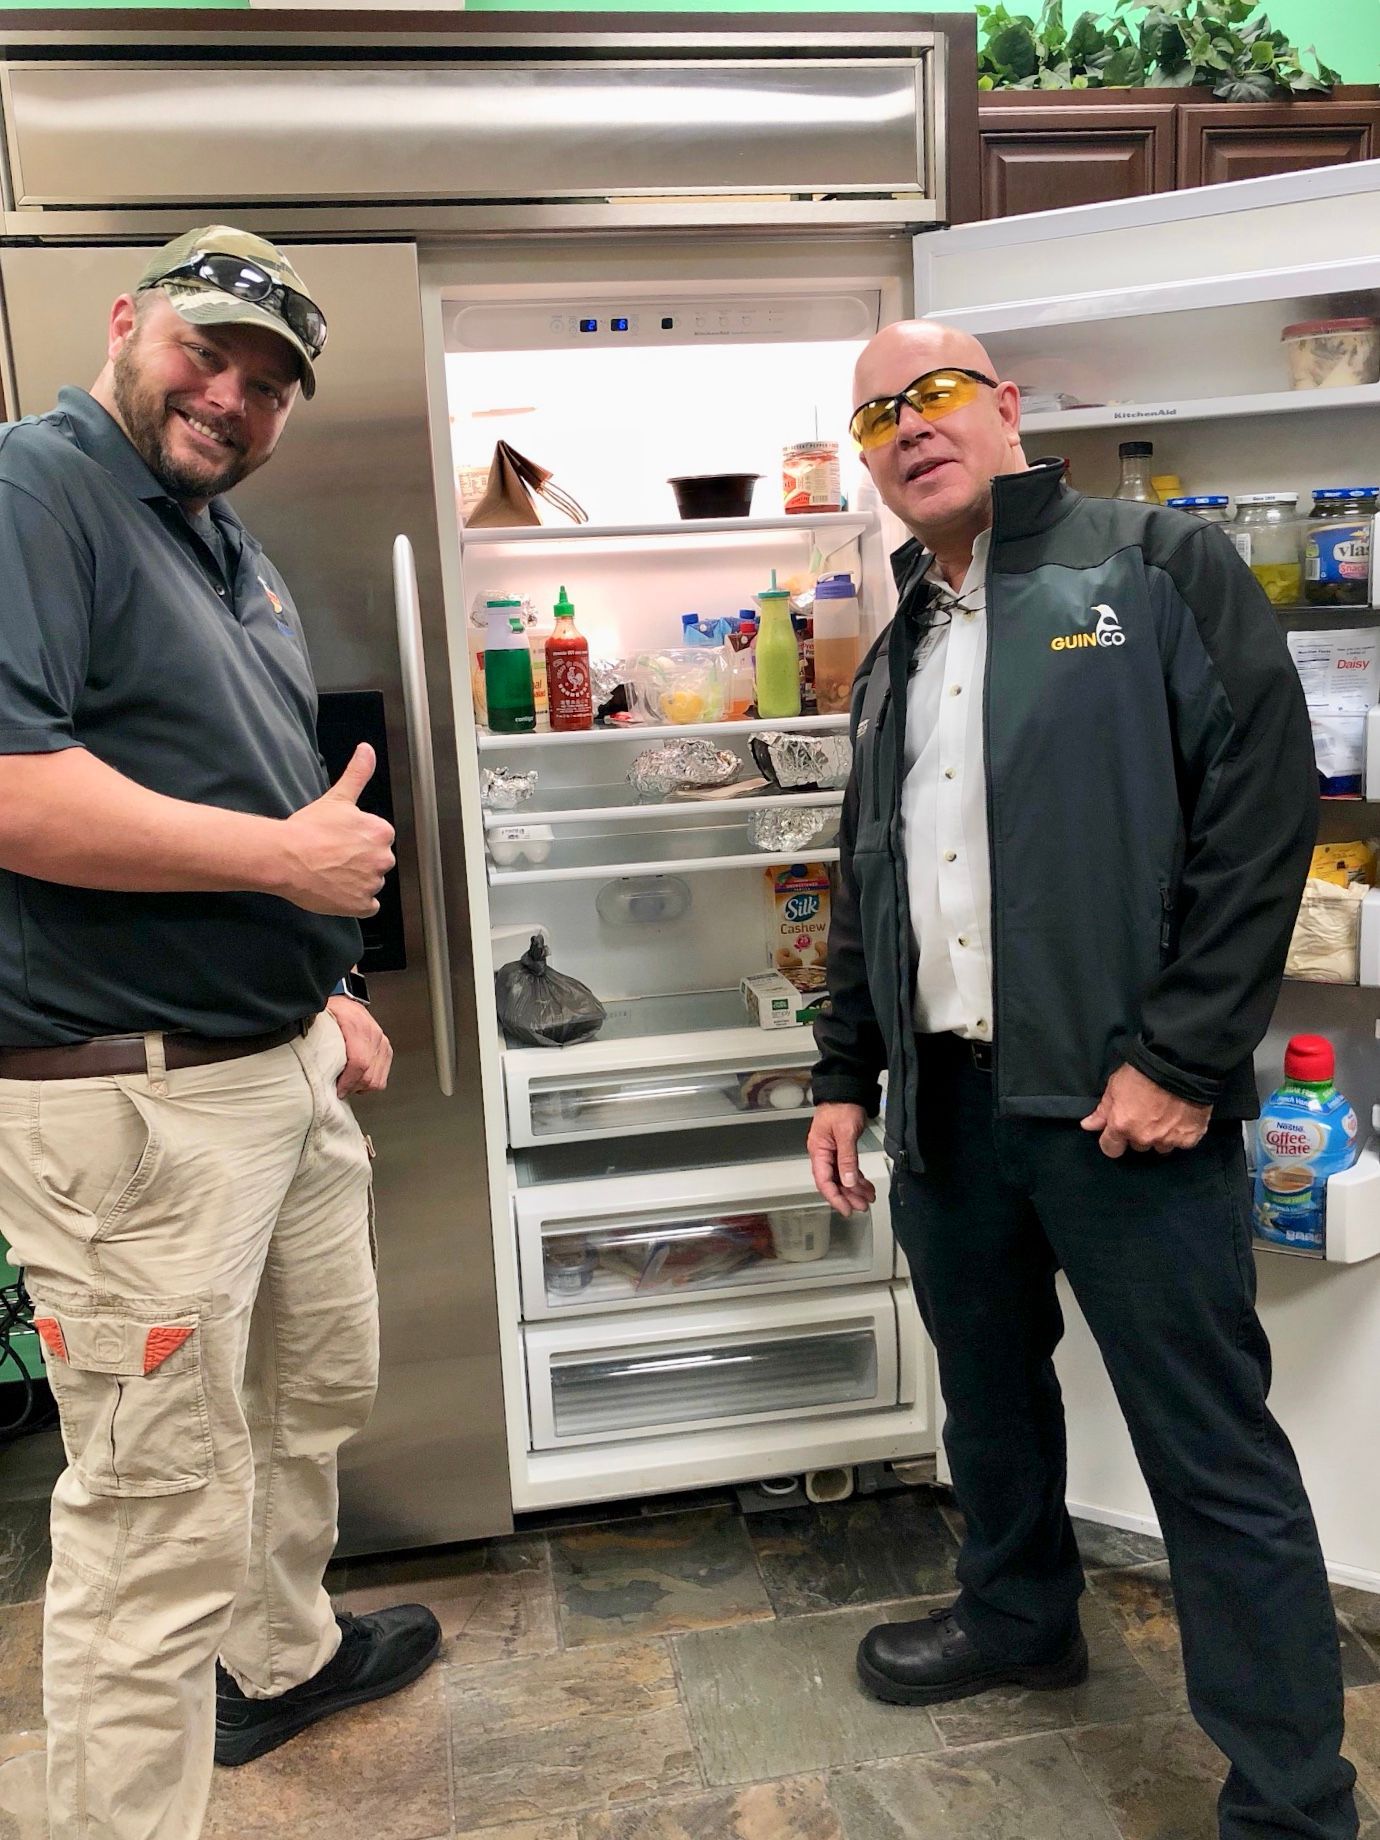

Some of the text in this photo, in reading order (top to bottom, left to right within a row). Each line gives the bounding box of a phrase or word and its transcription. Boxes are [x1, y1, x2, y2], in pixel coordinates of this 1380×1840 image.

[619, 319, 626, 329] 6
[1114, 409, 1177, 419] KitchenAid
[1337, 659, 1370, 671] Daisy
[785, 896, 819, 921] Silk
[780, 923, 826, 935] Cashew
